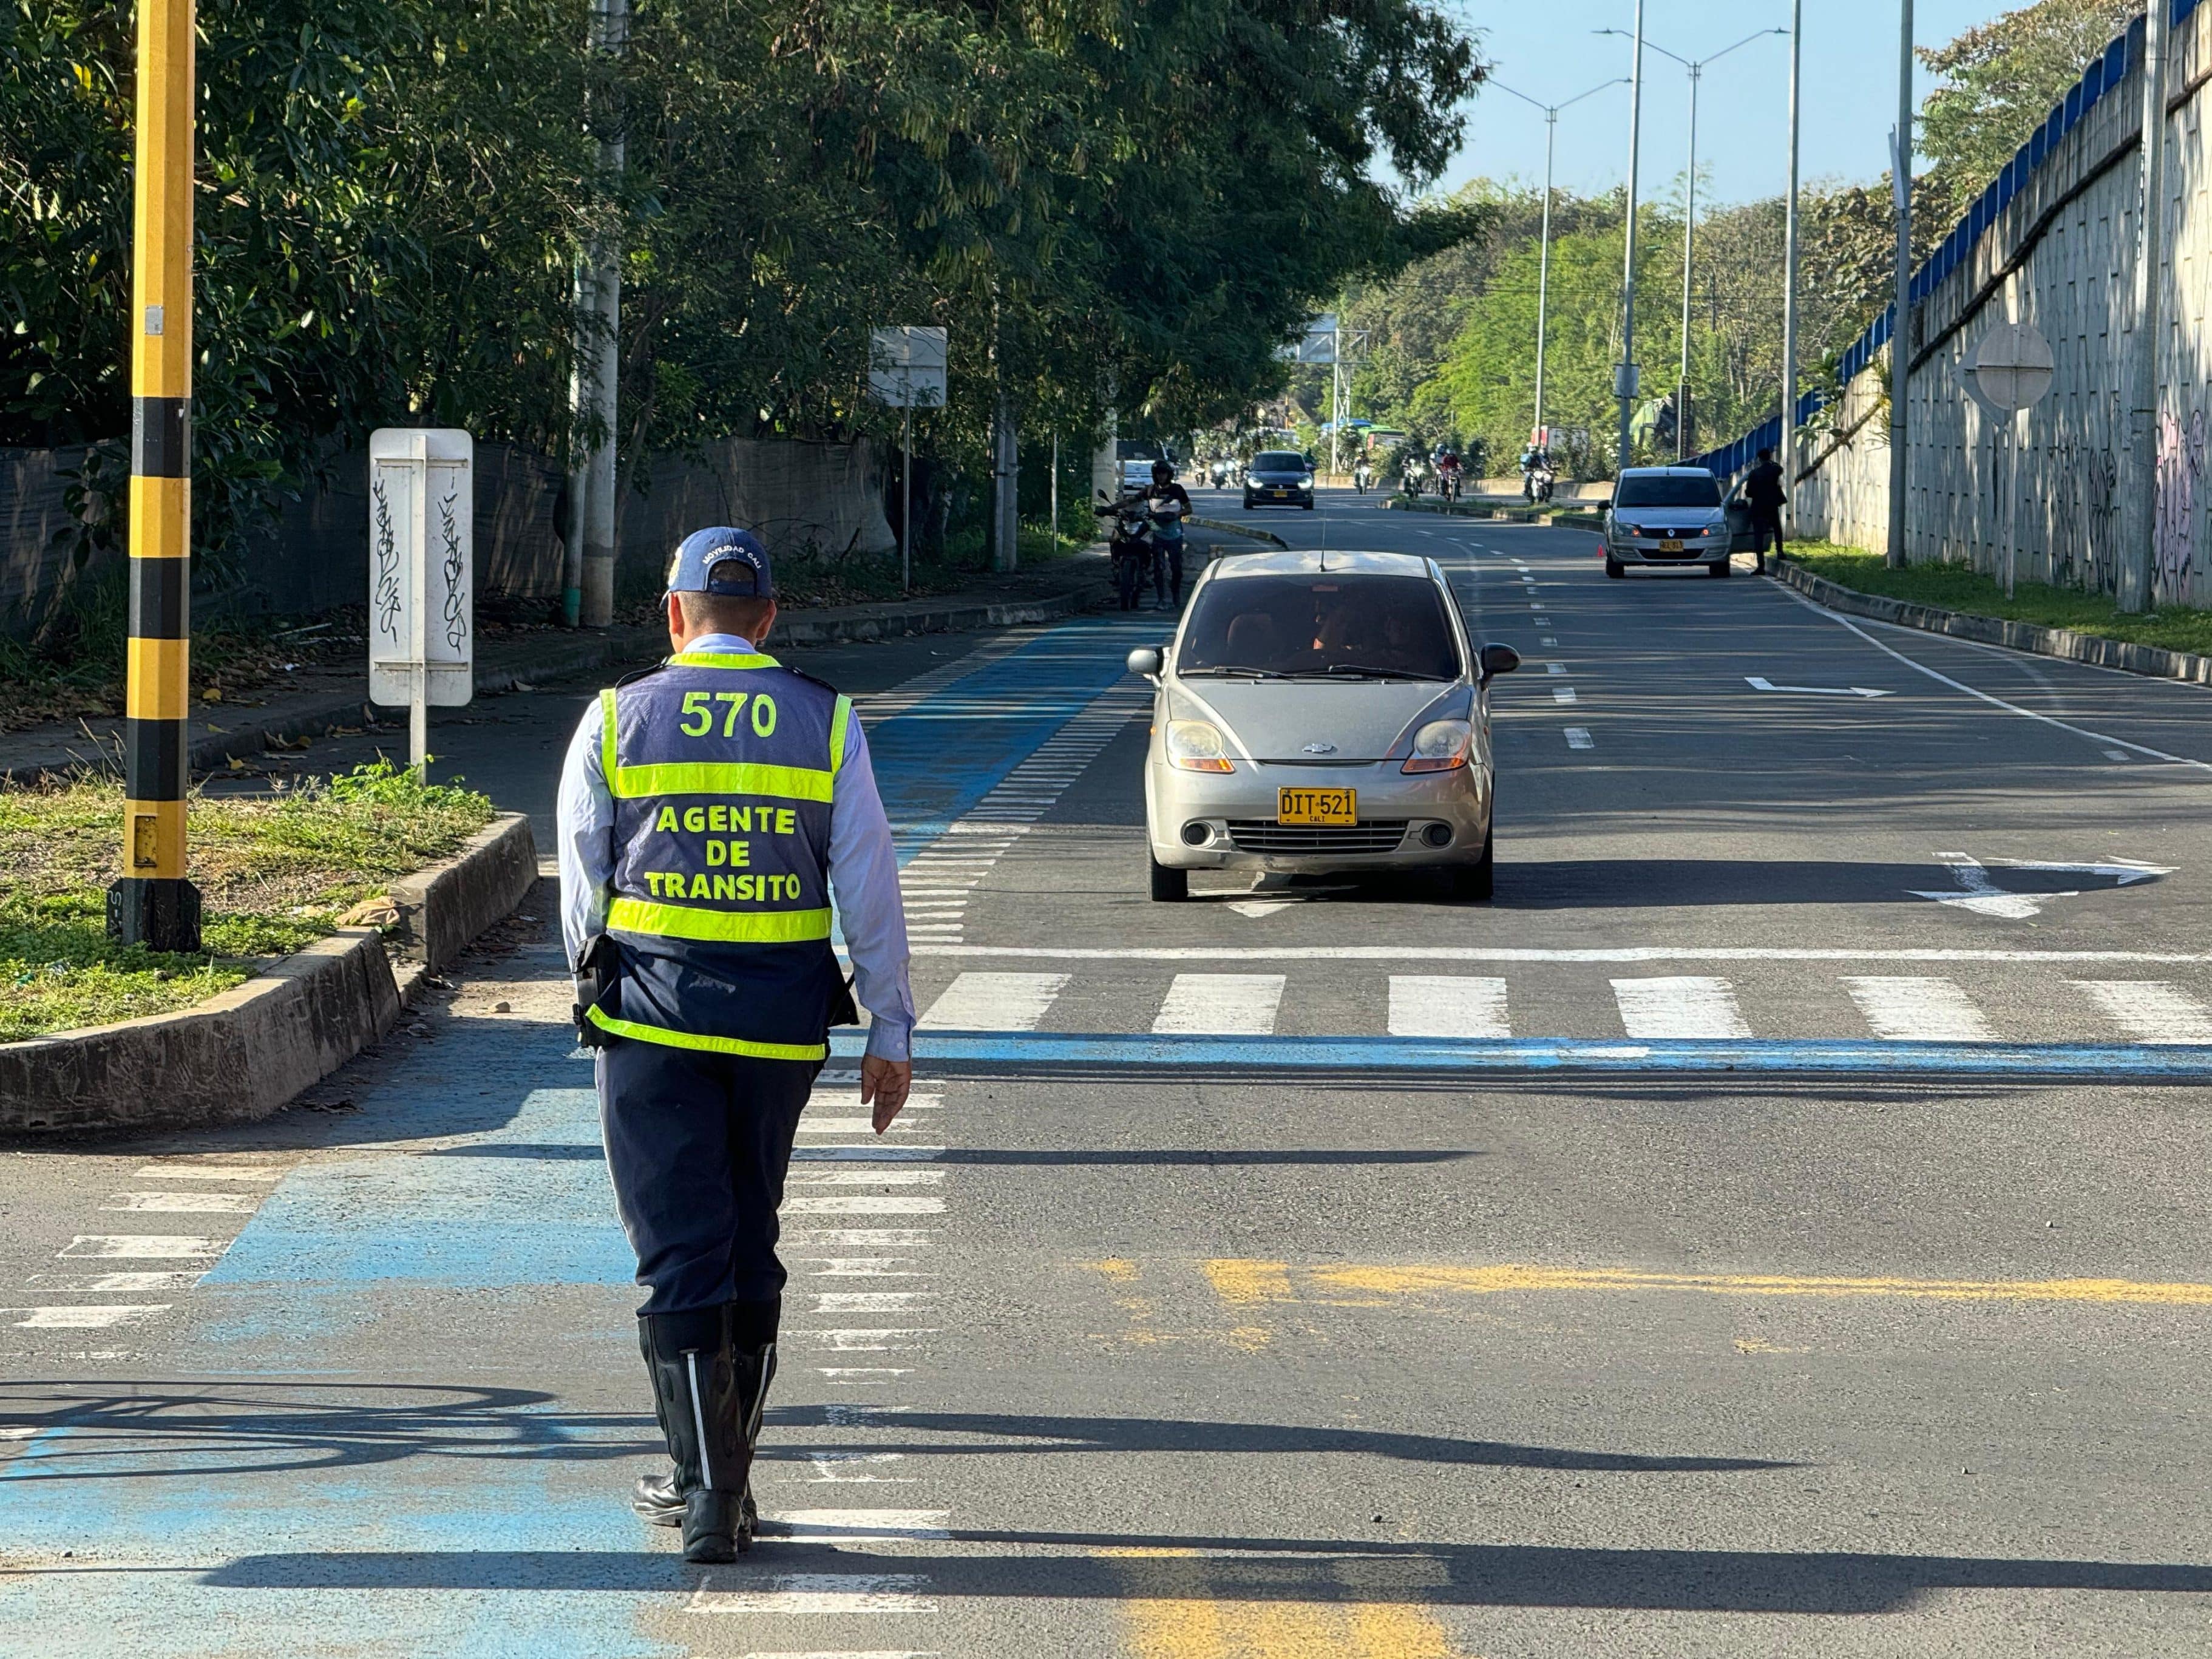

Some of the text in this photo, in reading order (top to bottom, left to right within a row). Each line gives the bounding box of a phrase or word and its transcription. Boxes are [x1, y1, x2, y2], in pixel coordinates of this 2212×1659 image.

[702, 545, 762, 569] MOVILIDAD CALI
[680, 692, 776, 737] 570
[656, 805, 796, 834] AGENTE
[707, 840, 750, 866] DE
[644, 872, 801, 901] TRANSITO
